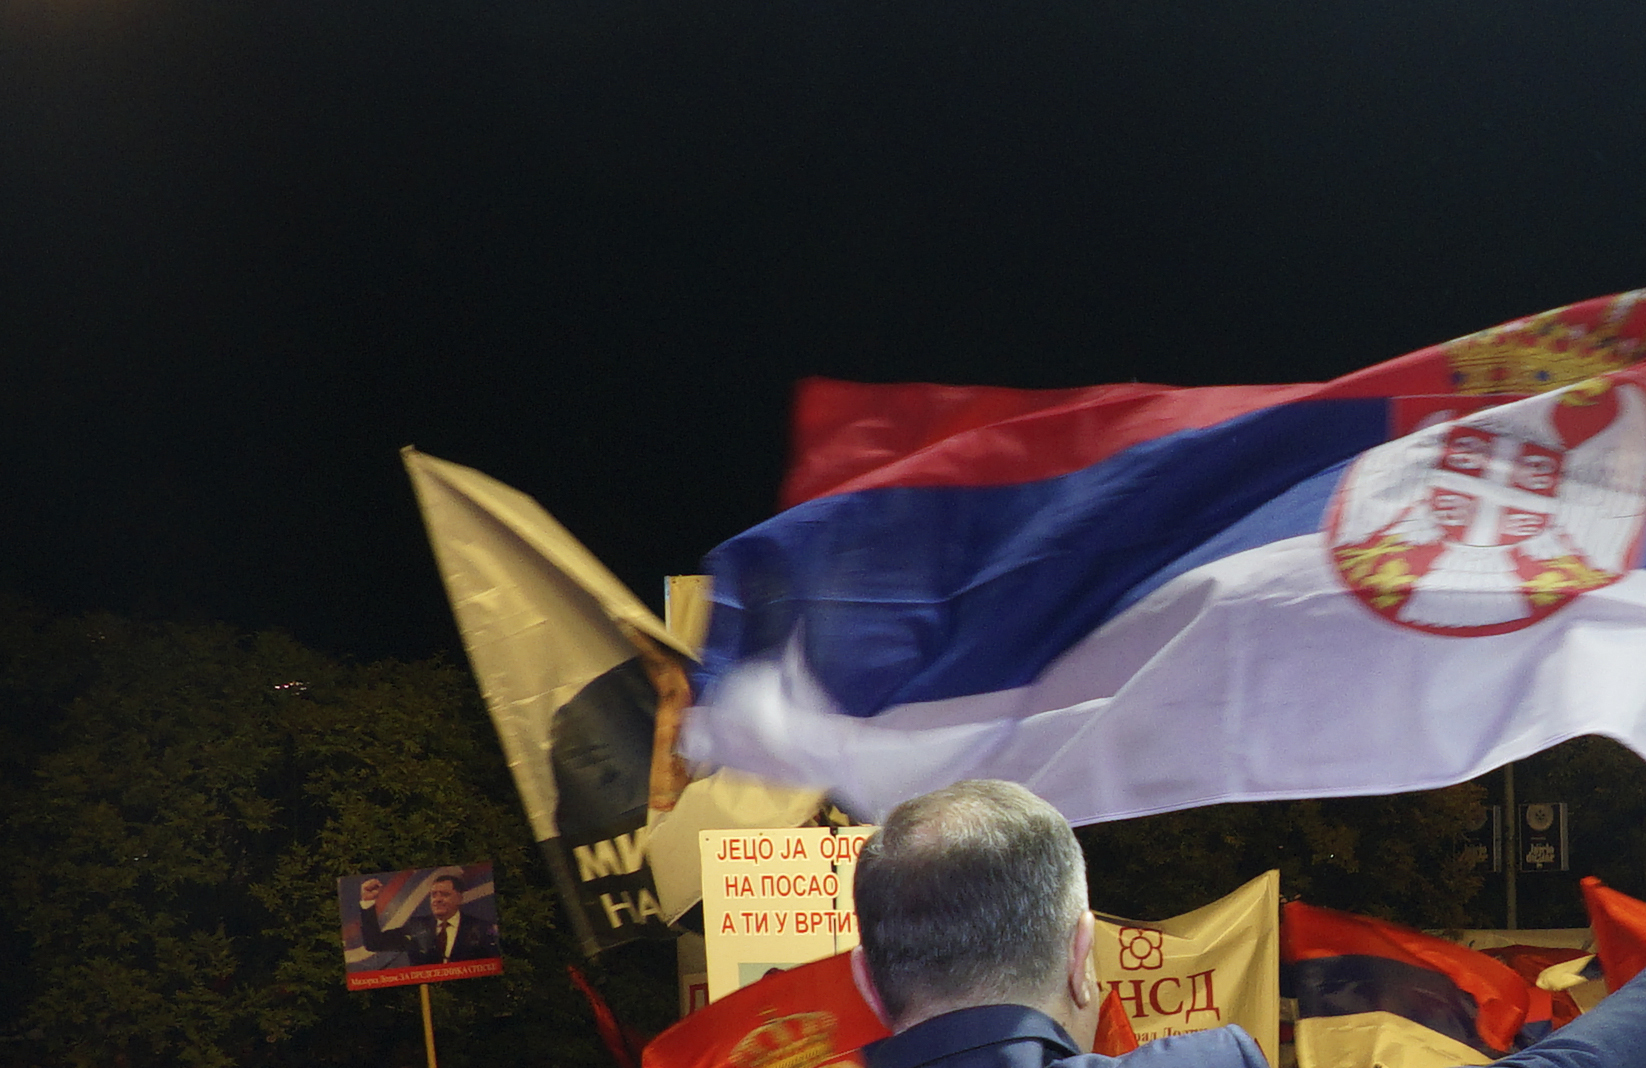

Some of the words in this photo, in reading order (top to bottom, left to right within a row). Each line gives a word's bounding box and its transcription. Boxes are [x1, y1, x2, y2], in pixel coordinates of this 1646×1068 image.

[717, 837, 774, 864] ЈЕЦО
[780, 837, 808, 860] ЈА
[725, 876, 755, 898] НА
[761, 874, 839, 897] ПОСАО
[721, 912, 737, 934] А
[741, 912, 768, 934] ТИ
[775, 912, 788, 934] У
[795, 911, 858, 934] ВРТИ
[1097, 968, 1220, 1024] НСД
